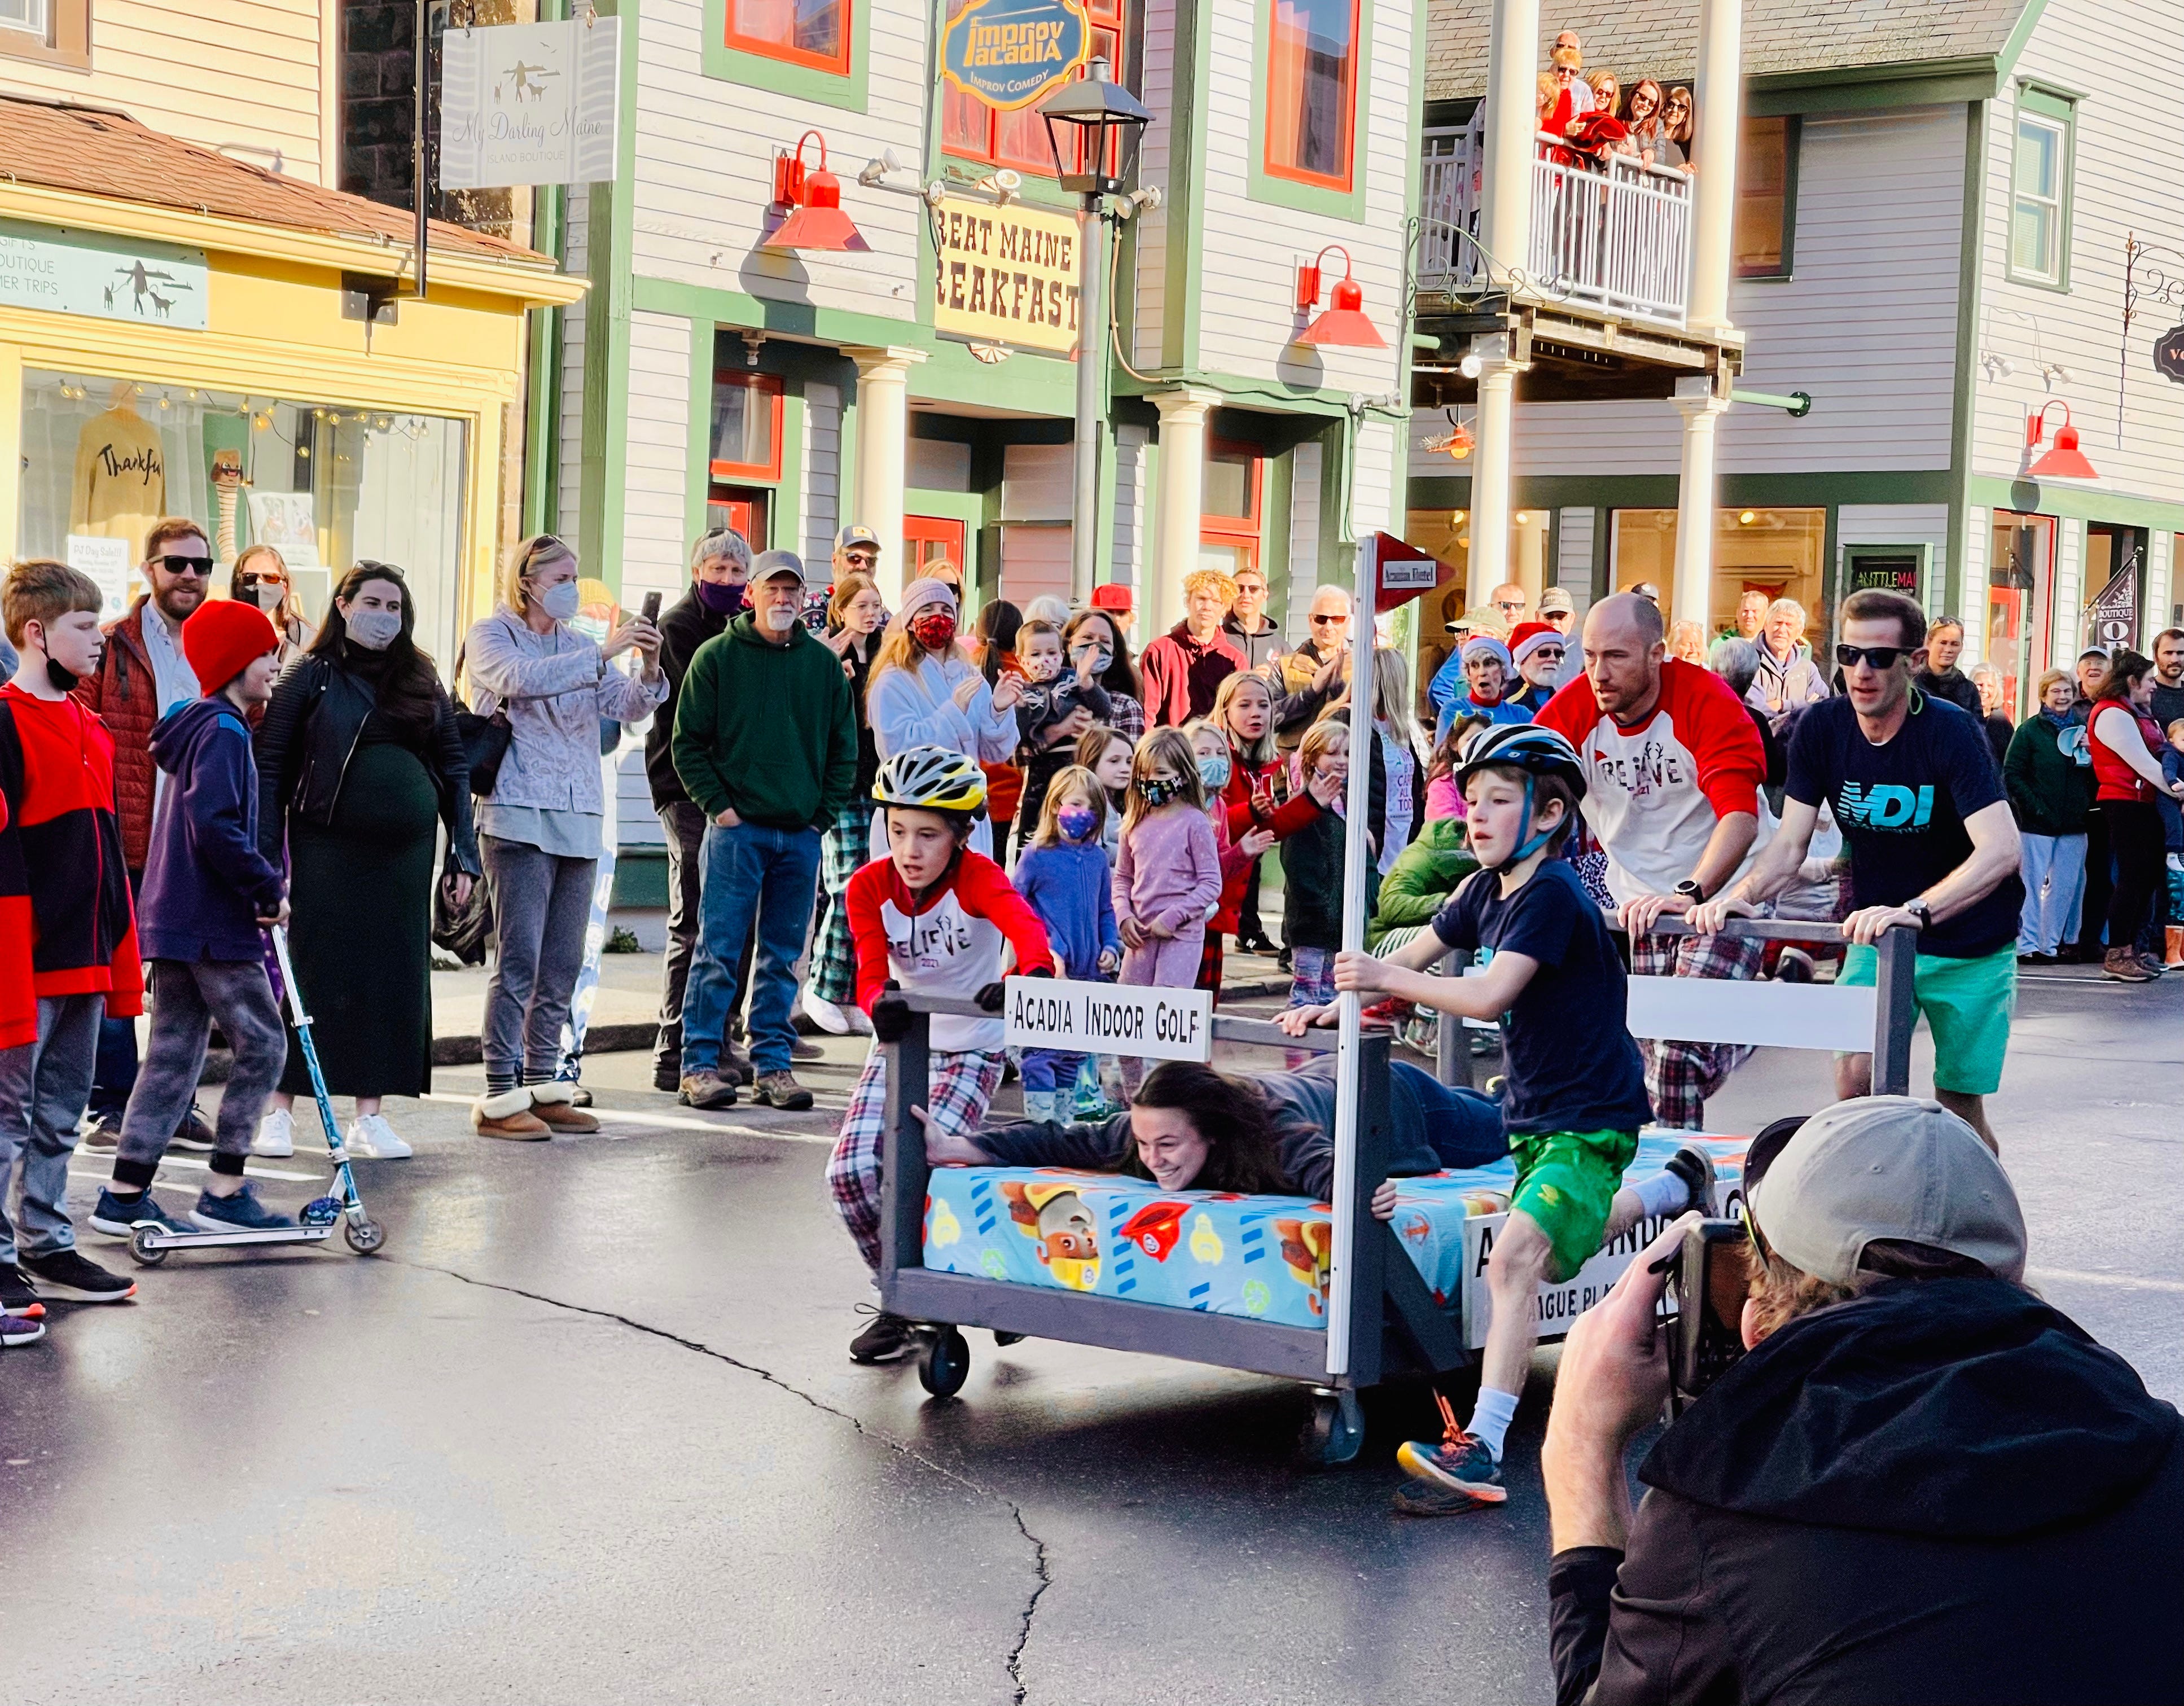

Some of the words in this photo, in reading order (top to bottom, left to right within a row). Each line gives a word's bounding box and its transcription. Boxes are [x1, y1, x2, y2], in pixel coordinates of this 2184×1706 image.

[970, 72, 1005, 93] IMPROV
[1007, 69, 1049, 92] COMEDY
[452, 112, 484, 151] My
[488, 112, 545, 148] Darling
[550, 106, 603, 137] Maine
[487, 153, 518, 164] ISLAND
[520, 150, 564, 162] BOUTIQUE
[999, 222, 1072, 272] MAINE
[0, 275, 19, 290] ER
[24, 278, 58, 295] TRIPS
[85, 545, 100, 558] Day
[2099, 608, 2133, 619] BOUTIQUE
[1014, 990, 1073, 1034] ACADIA
[1085, 995, 1144, 1040] INDOOR
[1155, 1001, 1198, 1043] GOLF
